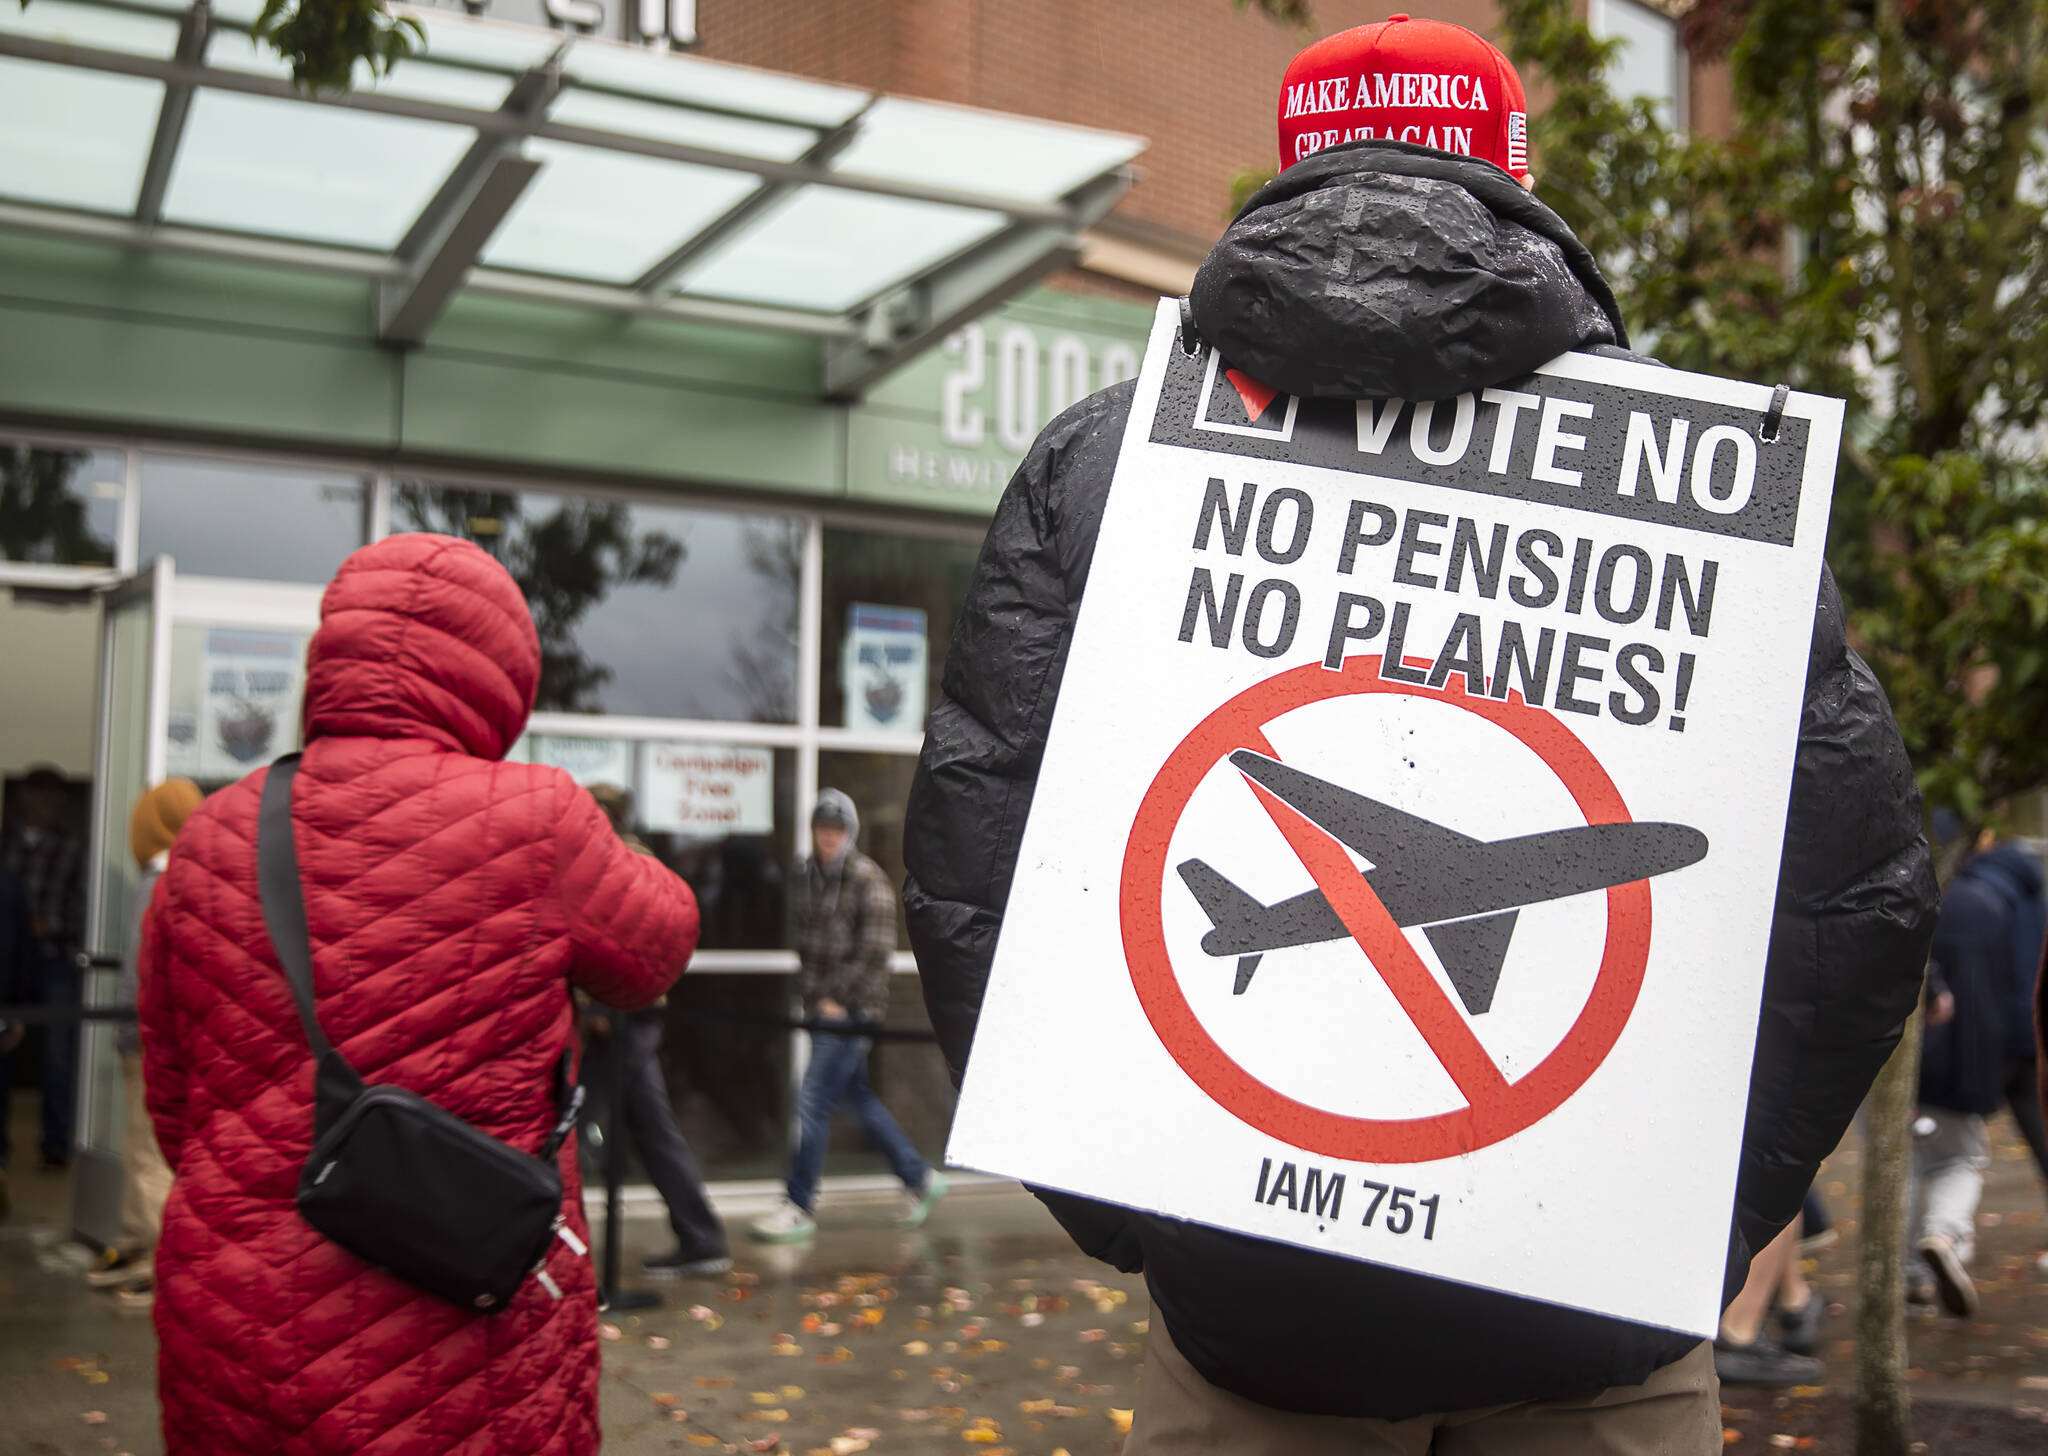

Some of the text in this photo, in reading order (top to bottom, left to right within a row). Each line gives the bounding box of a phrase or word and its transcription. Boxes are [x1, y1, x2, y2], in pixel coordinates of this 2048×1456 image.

[1284, 73, 1489, 119] MAKE AMERICA
[1356, 387, 1758, 515] VOTE NO
[1192, 478, 1720, 638] NO PENSION
[1177, 567, 1697, 732] NO PLANES!
[1254, 1157, 1441, 1241] IAM 751
